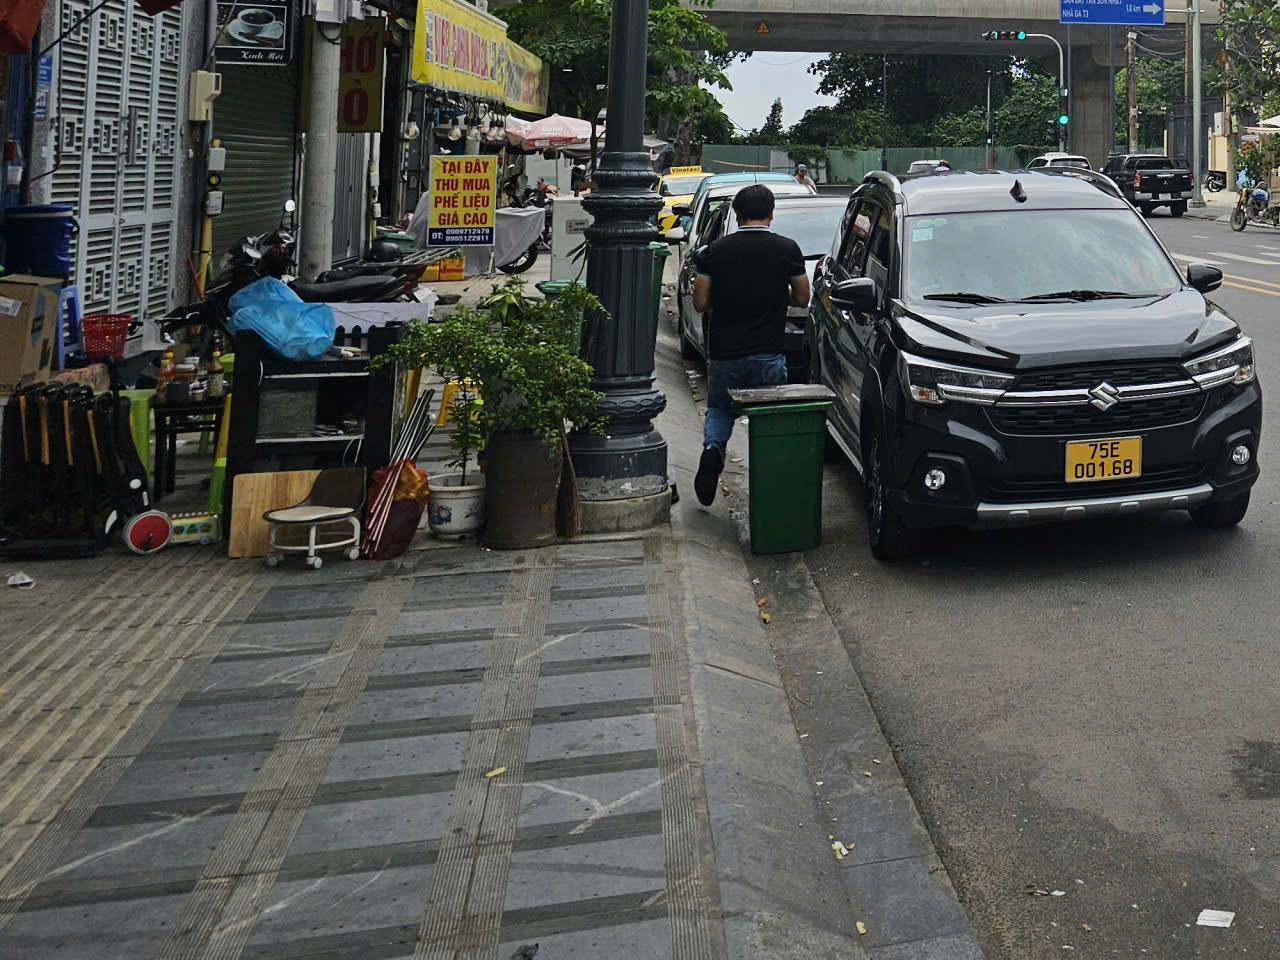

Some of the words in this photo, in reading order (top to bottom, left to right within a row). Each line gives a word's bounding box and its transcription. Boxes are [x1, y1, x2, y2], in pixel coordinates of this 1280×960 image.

[1062, 9, 1074, 18] NHÀ
[1074, 10, 1082, 18] GA
[1083, 10, 1089, 18] T3
[1133, 4, 1142, 12] km
[341, 23, 377, 73] HỞ
[343, 78, 369, 127] Ò
[442, 161, 461, 176] TẠI
[465, 158, 489, 174] ĐÂY
[435, 178, 458, 191] THU
[463, 178, 490, 191] MUA
[434, 192, 460, 208] PHẾ
[463, 193, 490, 210] LIỆU
[438, 210, 459, 226] GIÁ
[463, 212, 488, 225] CAO
[1088, 441, 1120, 460] 75E
[1074, 458, 1133, 479] 001.68
